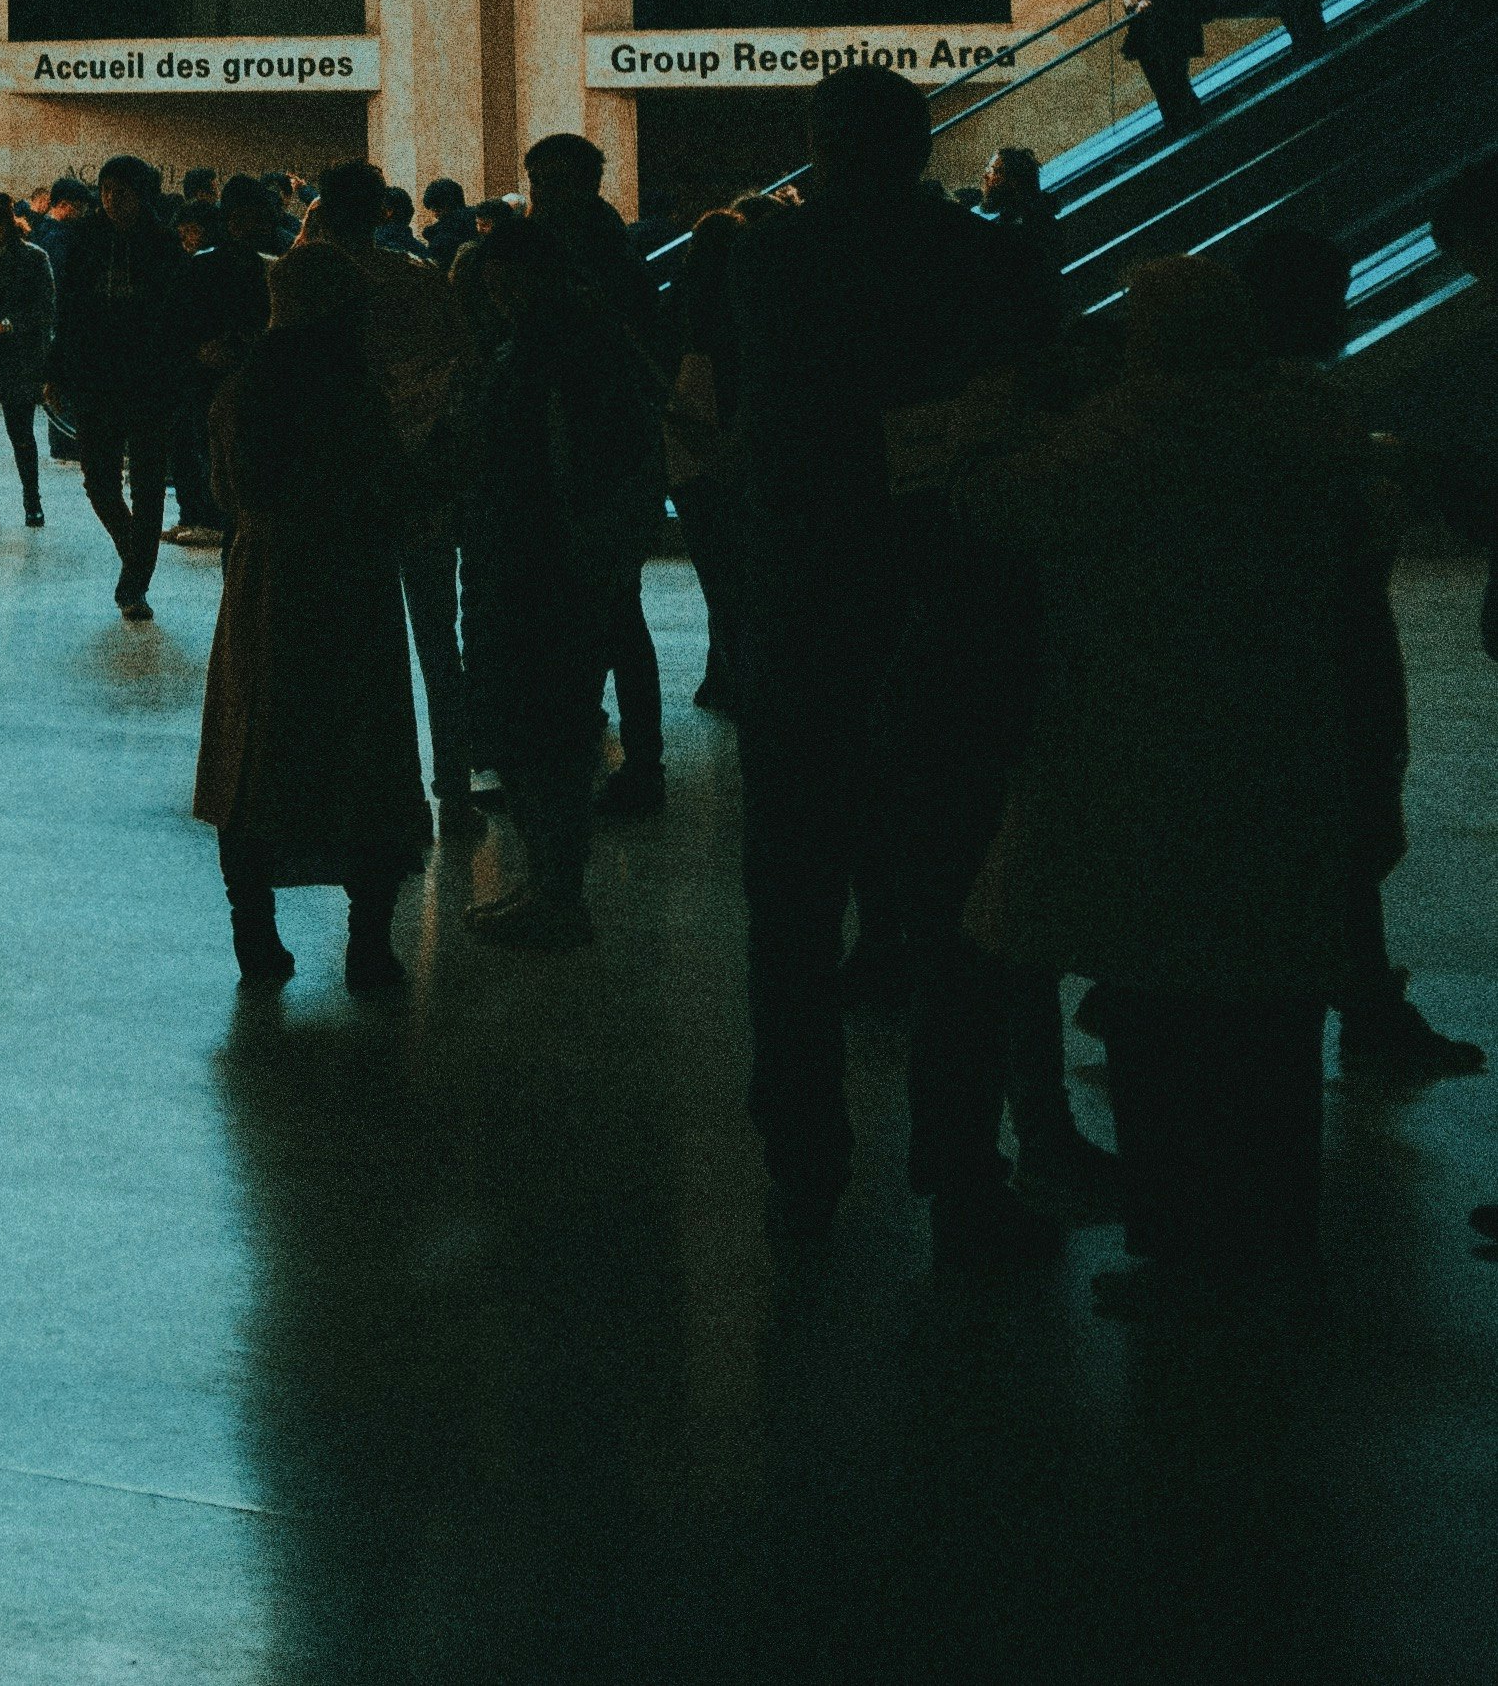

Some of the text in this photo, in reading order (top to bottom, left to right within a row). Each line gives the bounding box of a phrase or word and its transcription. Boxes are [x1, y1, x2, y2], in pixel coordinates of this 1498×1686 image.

[34, 52, 354, 83] Accueil des groupes
[611, 40, 1016, 78] Group Reception Area
